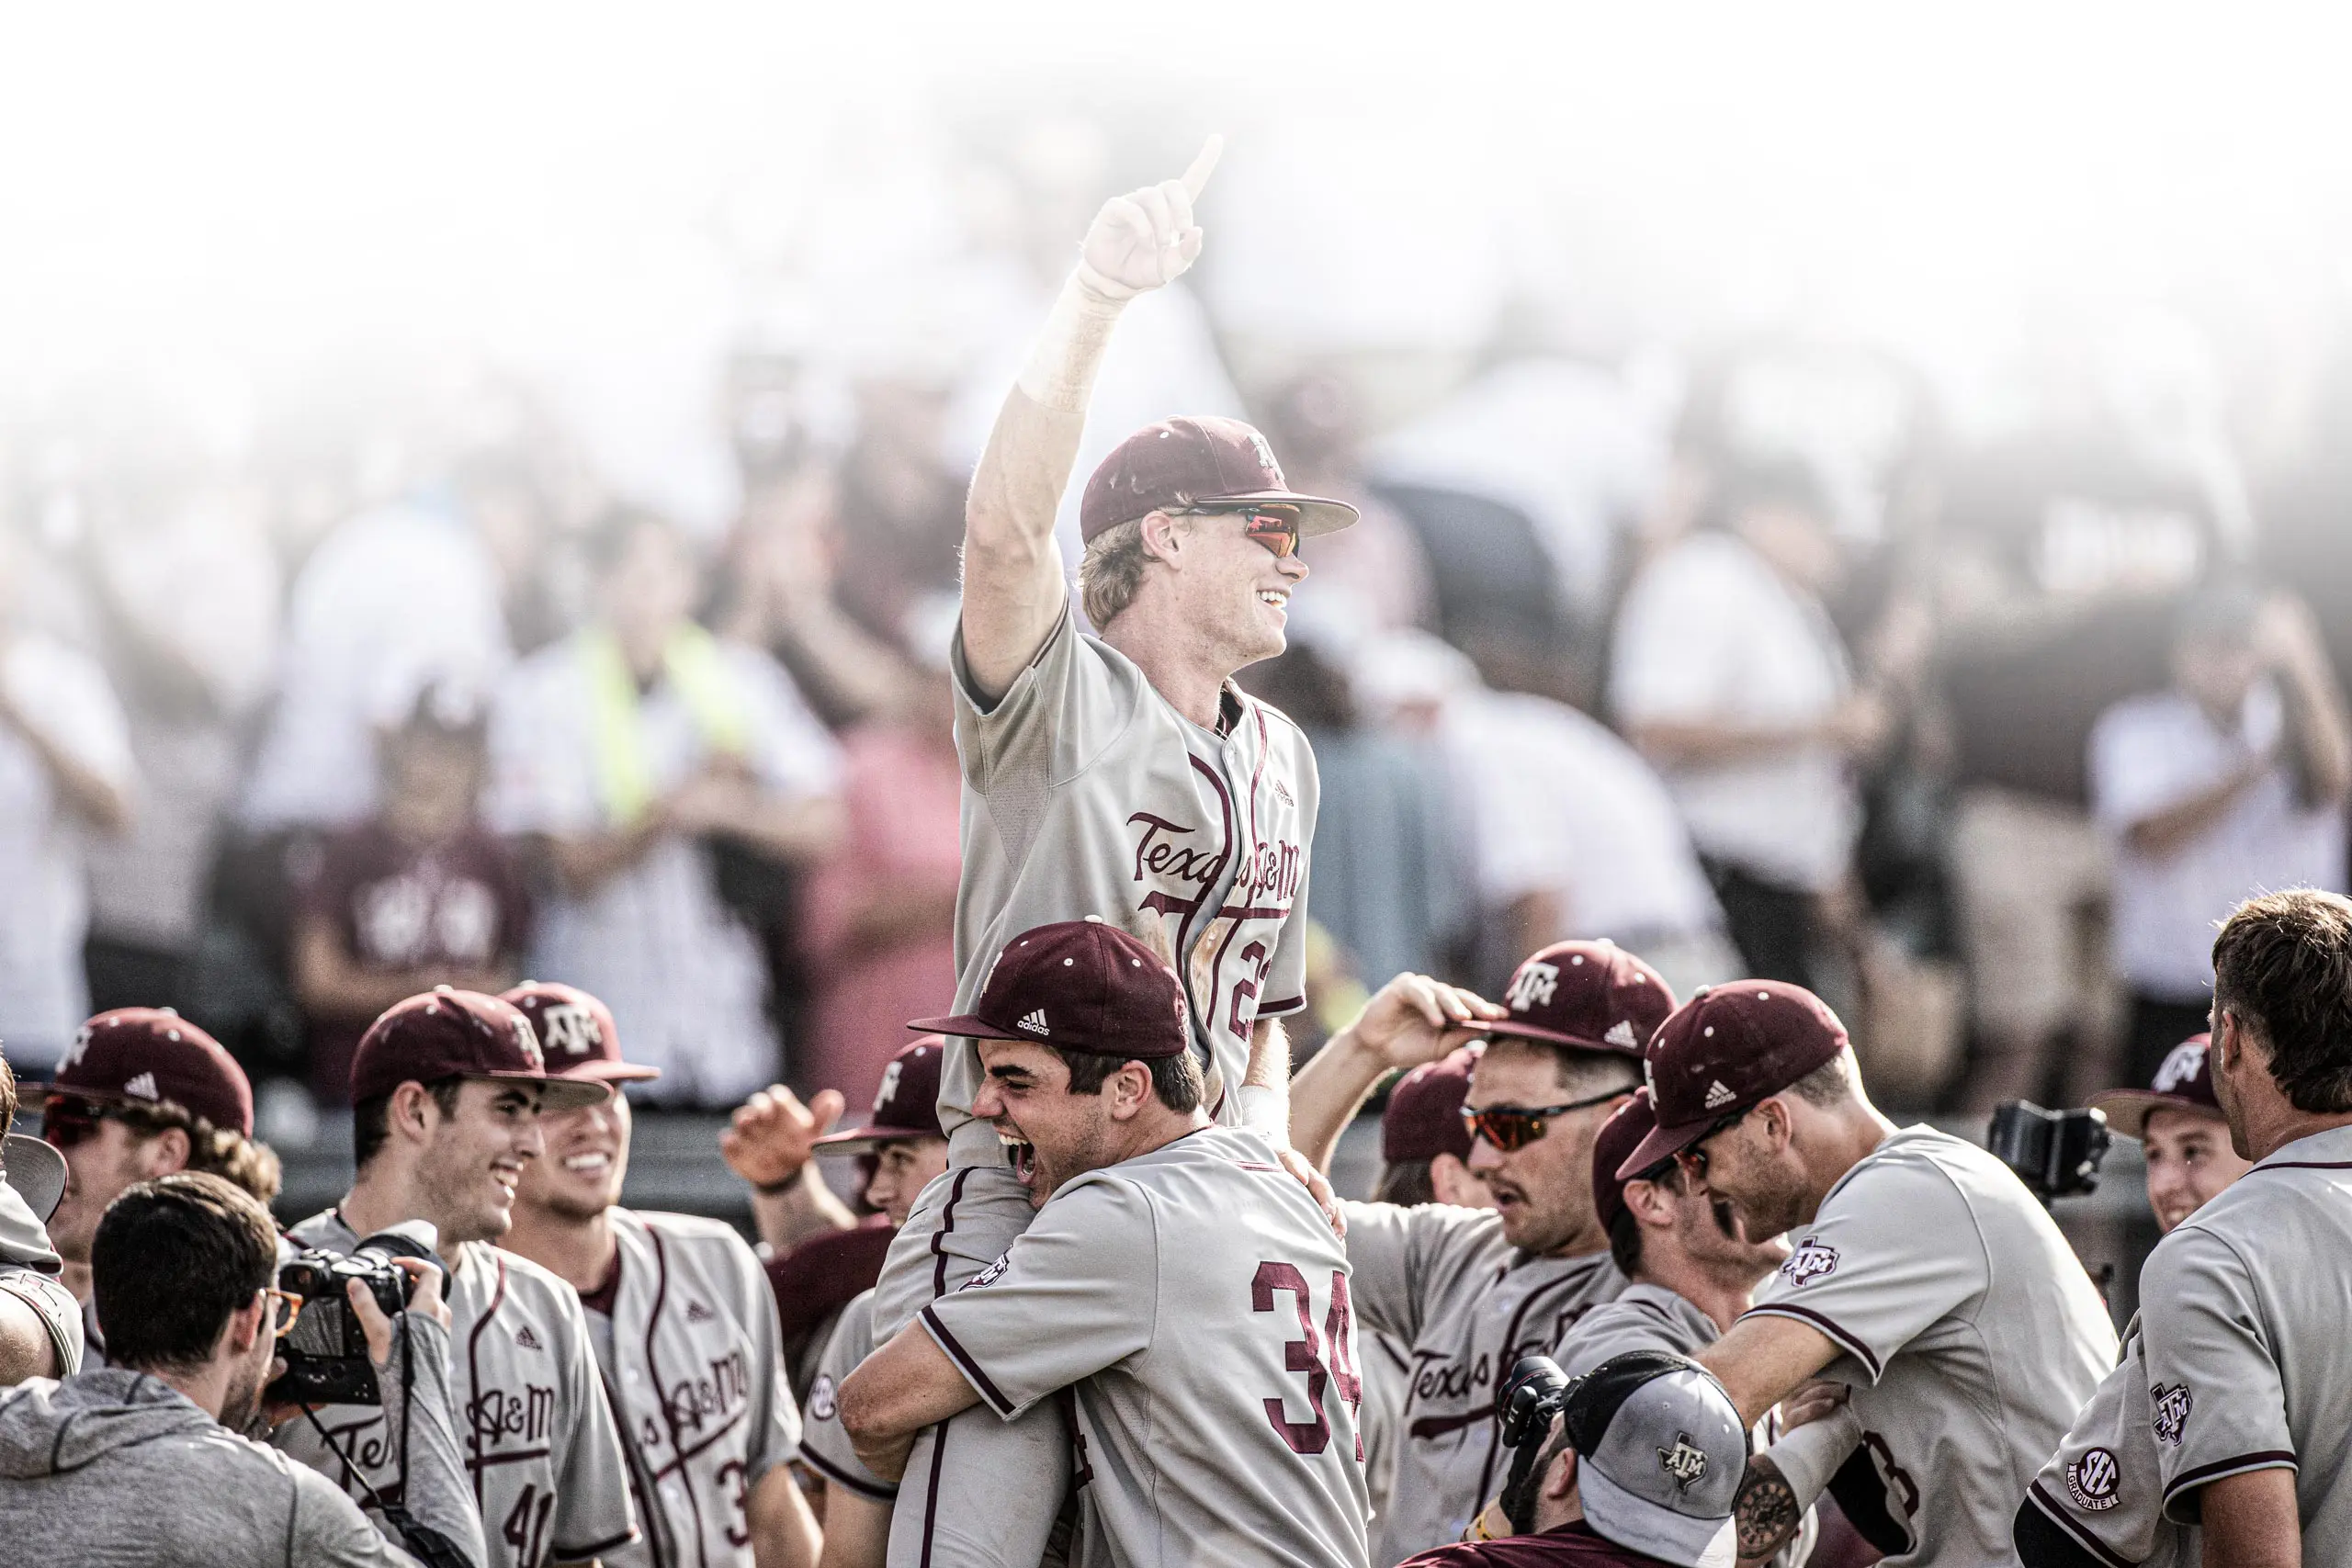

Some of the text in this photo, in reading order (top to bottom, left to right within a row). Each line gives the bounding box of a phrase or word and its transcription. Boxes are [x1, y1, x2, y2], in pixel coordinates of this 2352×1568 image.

[1228, 940, 1272, 1042] 2
[1017, 1020, 1050, 1036] adidas
[1251, 1261, 1367, 1462] 34
[466, 1382, 555, 1446] A&M
[1666, 1441, 1704, 1479] ATM
[2080, 1450, 2116, 1495] SEC
[2068, 1474, 2108, 1509] GRADUATE
